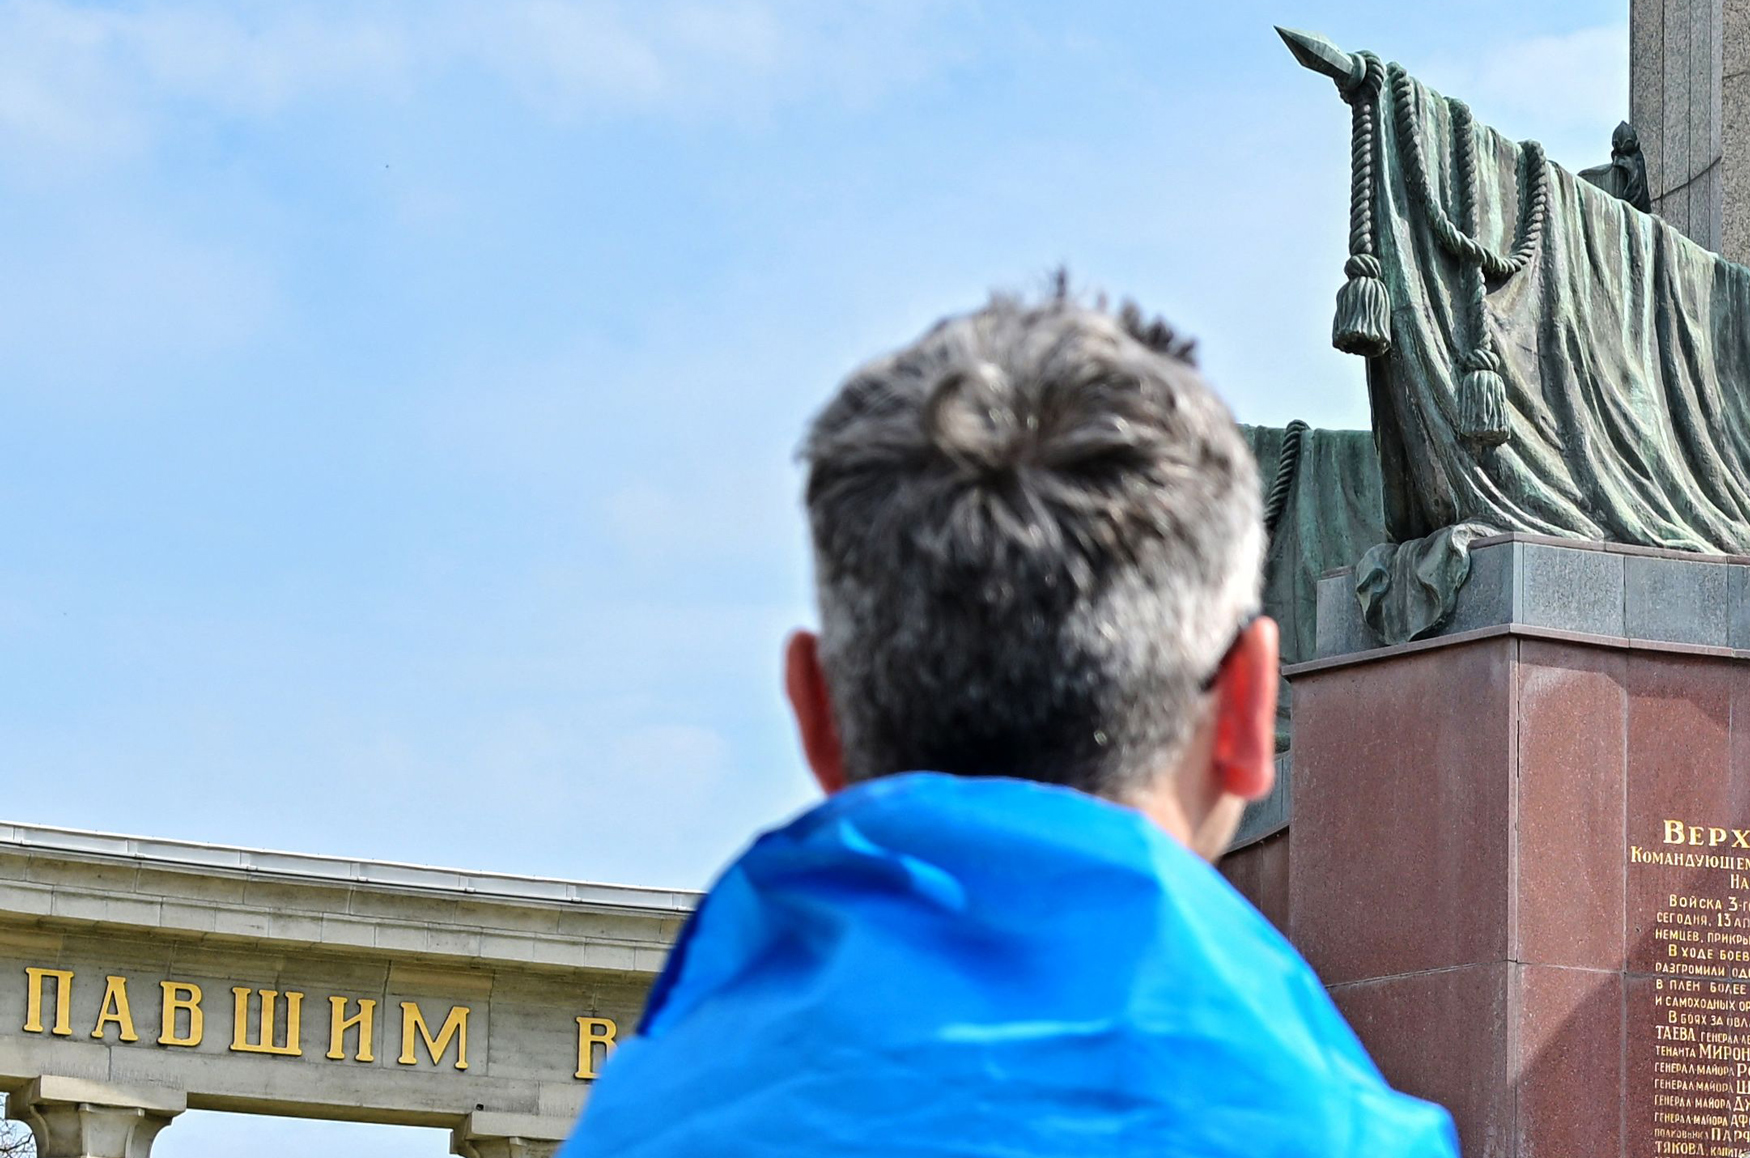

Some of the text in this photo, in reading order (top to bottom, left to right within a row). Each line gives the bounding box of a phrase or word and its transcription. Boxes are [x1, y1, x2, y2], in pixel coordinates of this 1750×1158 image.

[1669, 893, 1722, 910] ВОЙСКА
[1681, 946, 1714, 960] ХОДЕ
[1719, 949, 1750, 962] БОЕВ
[1655, 962, 1725, 977] РАЗГРОМИЛИ
[1669, 979, 1700, 992] ПЛЕН
[1710, 981, 1747, 995] БОЛЕЕ
[1665, 996, 1735, 1011] САМОХОДНЫХ
[23, 966, 471, 1071] ПАВШИМ
